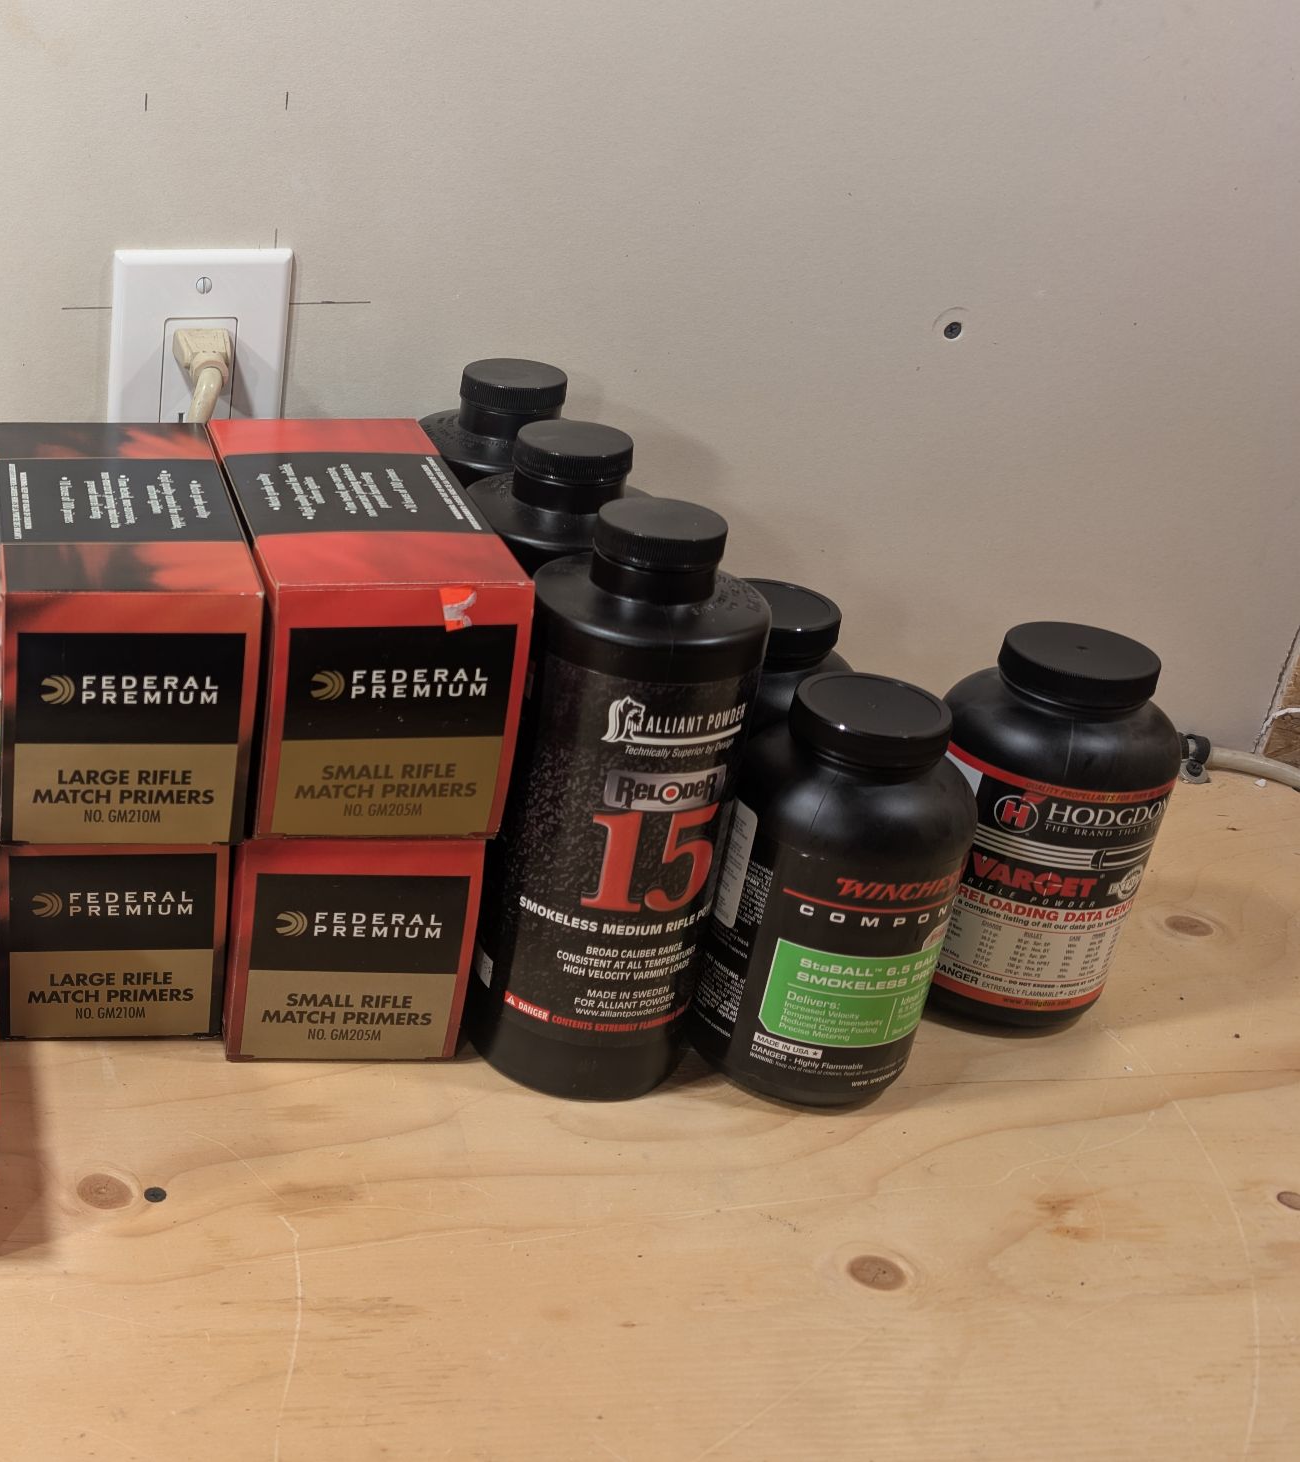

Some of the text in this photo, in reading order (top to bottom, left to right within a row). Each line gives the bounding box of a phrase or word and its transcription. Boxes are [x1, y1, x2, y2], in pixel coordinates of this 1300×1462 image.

[83, 675, 219, 690] FEDERAL
[352, 668, 488, 684] FEDERAL
[82, 691, 218, 705] PREMIUM
[351, 683, 486, 699] PREMIUM
[646, 704, 746, 733] ALLIANT POWDER
[58, 770, 192, 785] LARGE RIFLE
[322, 763, 456, 780] SMALL RIFLE
[32, 789, 214, 805] MATCH PRIMERS
[295, 783, 476, 799] MATCH PRIMERS
[84, 810, 161, 823] NO. GM210M
[344, 803, 422, 816] NO. GM205M
[581, 802, 719, 912] 15
[973, 852, 1098, 898] VARGET
[70, 891, 193, 904] FEDERAL
[959, 885, 1100, 922] RELOADING DATA
[69, 904, 192, 917] PREMIUM
[519, 896, 694, 936] SMOKELESS MEDIUM RIFLE
[315, 912, 442, 925] FEDERAL
[314, 925, 441, 939] PREMIUM
[50, 972, 172, 986] LARGE RIFLE
[796, 971, 907, 990] SMOKELESS
[27, 987, 193, 1004] MATCH PRIMERS
[587, 985, 670, 999] MADE IN SWEDEN
[286, 993, 412, 1008] SMALL RIFLE
[786, 991, 840, 1010] Delivers:
[75, 1006, 146, 1020] NO. GM210M
[261, 1010, 432, 1025] MATCH PRIMERS
[519, 1002, 548, 1020] DANGER
[307, 1029, 381, 1041] NO. GM205M
[757, 1035, 780, 1048] MADE
[792, 1046, 810, 1056] USA
